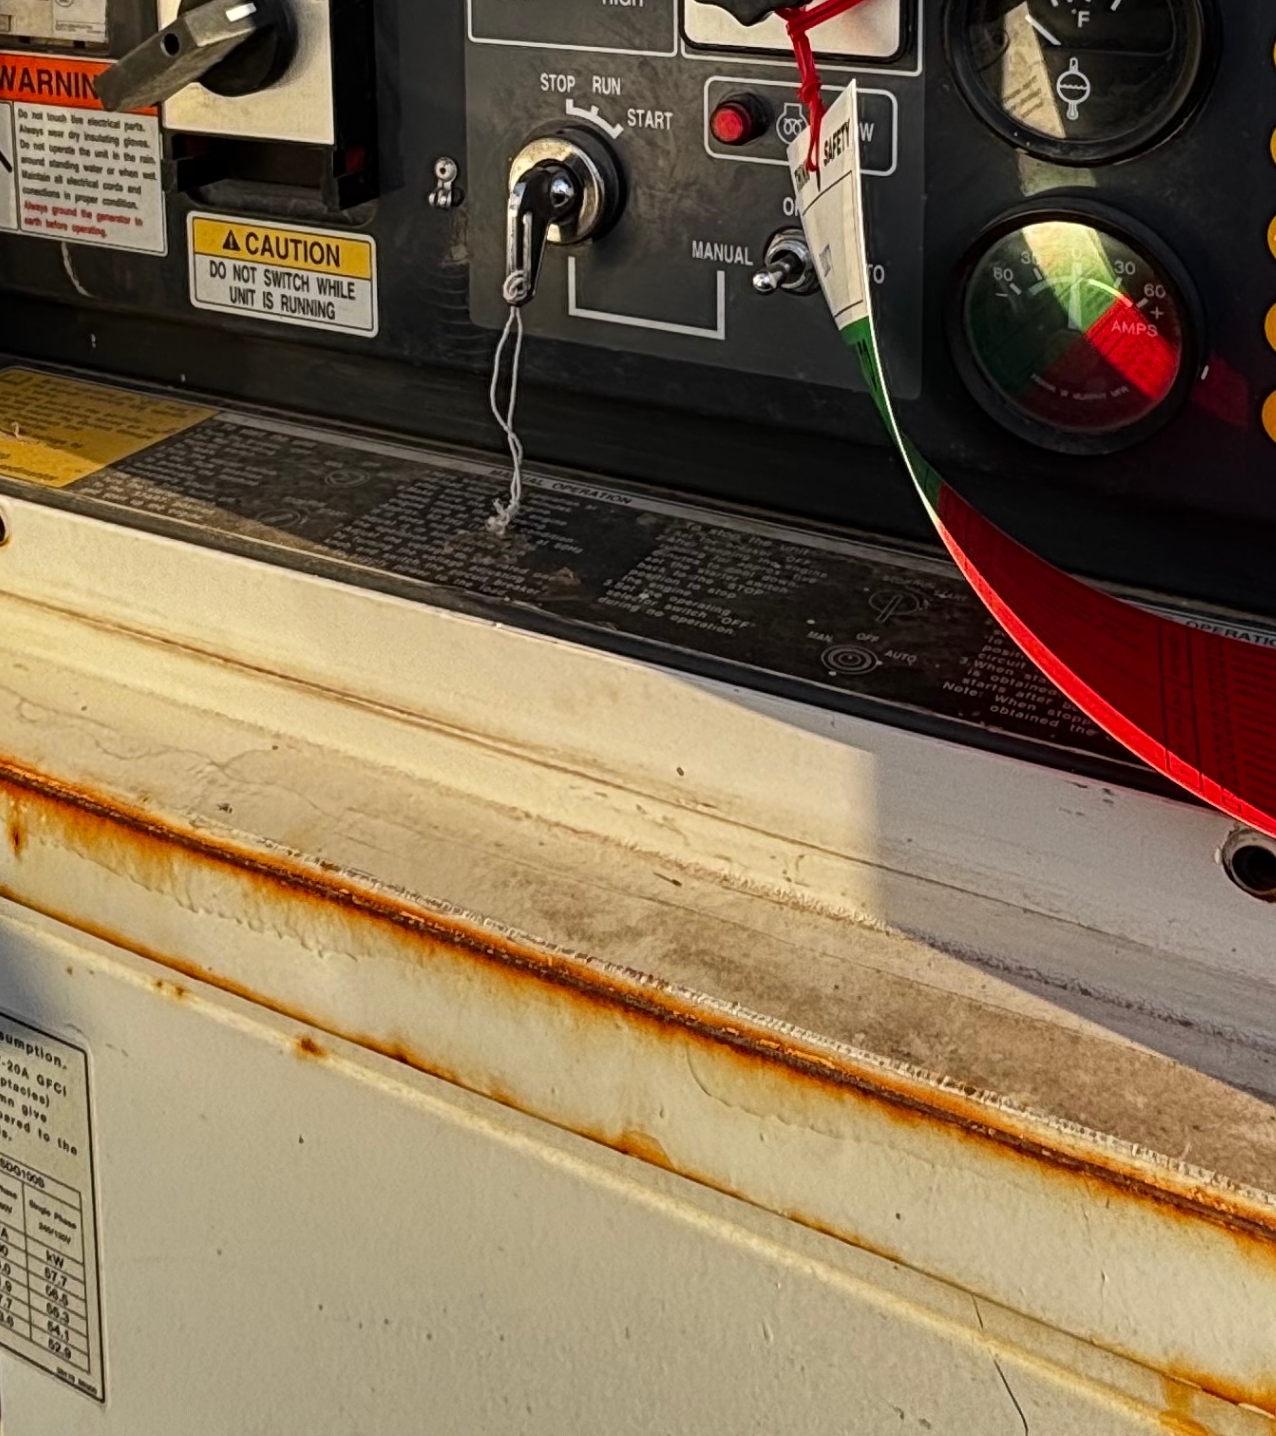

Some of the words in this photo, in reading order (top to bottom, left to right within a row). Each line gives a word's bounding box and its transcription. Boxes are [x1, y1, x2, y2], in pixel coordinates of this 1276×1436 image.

[541, 75, 575, 92] STOP
[593, 76, 621, 95] RUN
[627, 110, 673, 130] START
[823, 119, 850, 166] SAFETY
[246, 231, 341, 267] CAUTION
[692, 241, 753, 266] MANUAL
[1114, 260, 1136, 275] 30
[210, 260, 226, 279] DO
[233, 264, 256, 284] NOT
[264, 269, 309, 292] SWITCH
[317, 277, 356, 300] WHILE
[1144, 284, 1166, 298] 60
[230, 286, 255, 306] UNIT
[263, 291, 273, 309] IS
[281, 294, 335, 320] RUNNING
[1111, 321, 1158, 337] AMPS
[491, 470, 543, 485] MAUAL
[552, 482, 632, 504] OPERATION
[884, 650, 917, 663] AUTO
